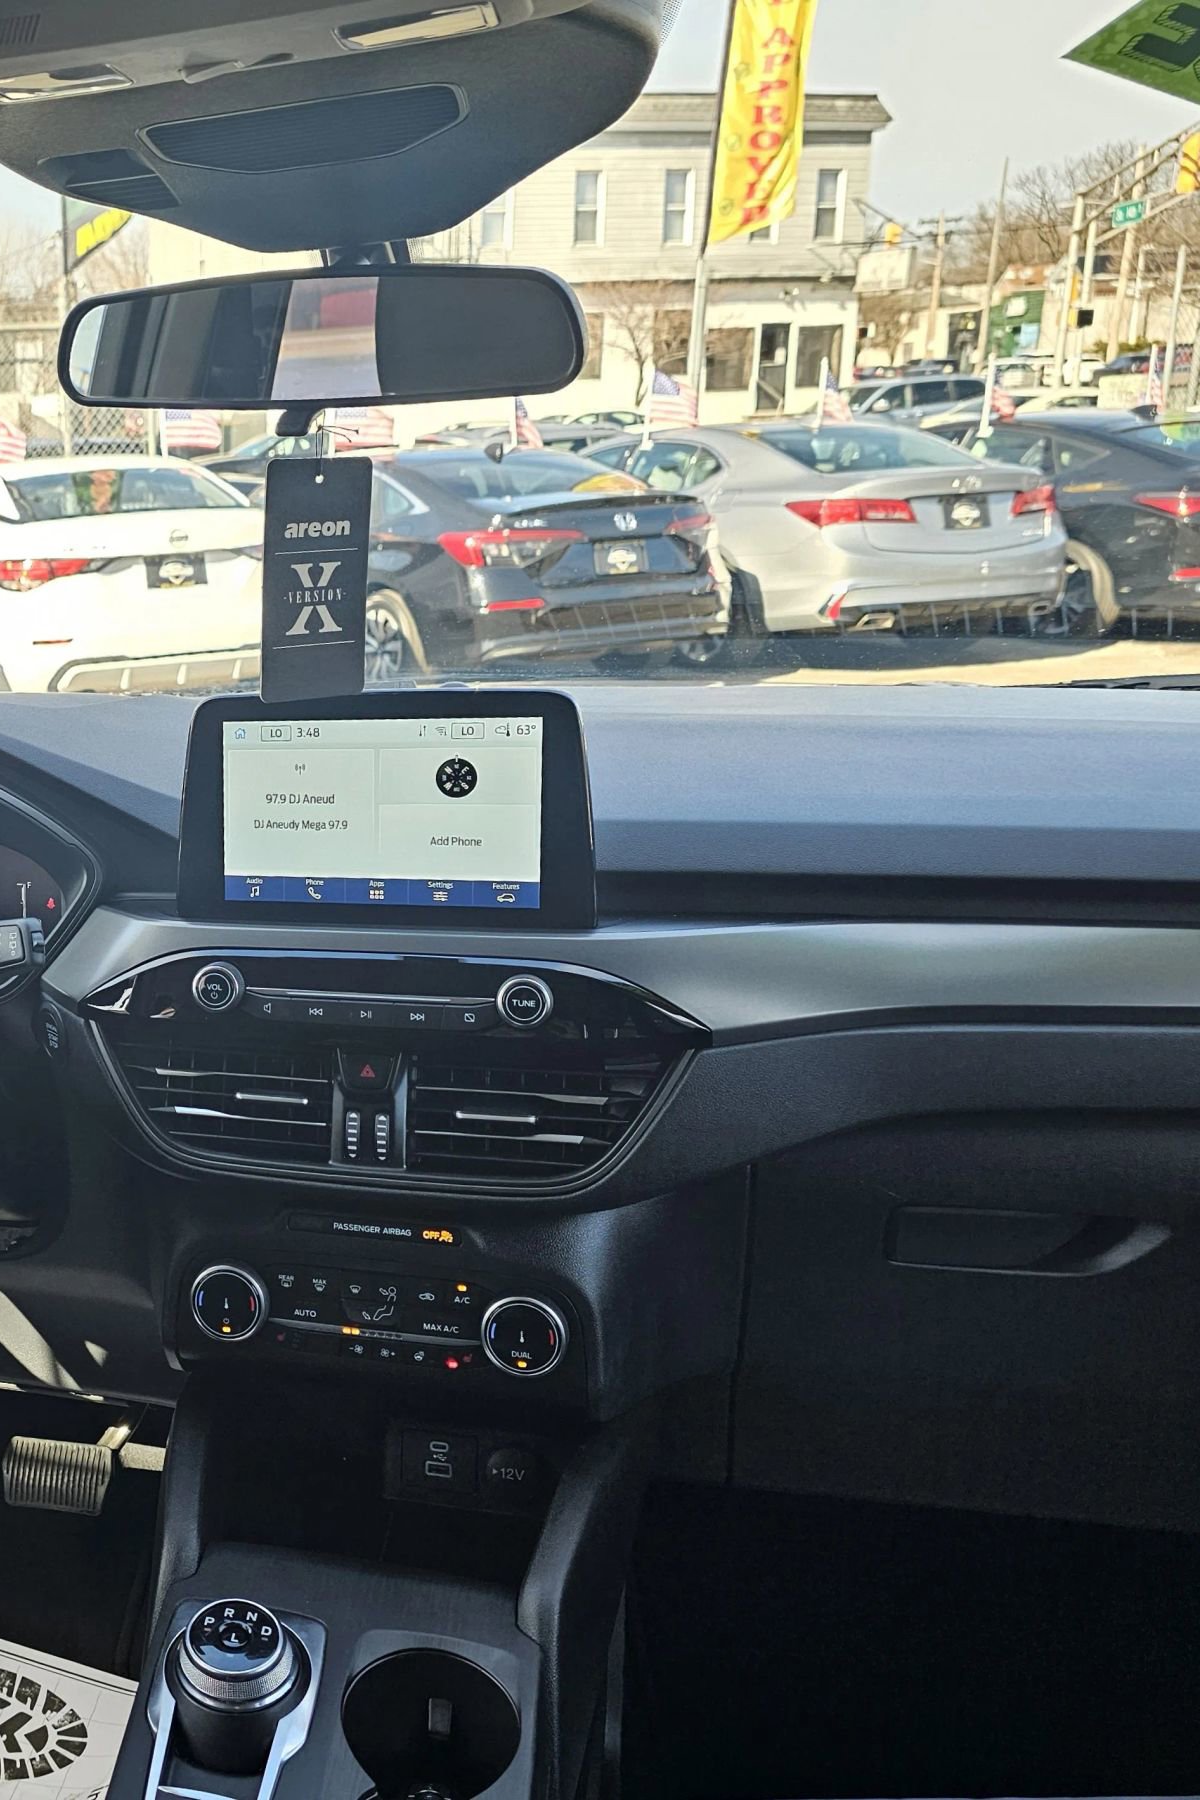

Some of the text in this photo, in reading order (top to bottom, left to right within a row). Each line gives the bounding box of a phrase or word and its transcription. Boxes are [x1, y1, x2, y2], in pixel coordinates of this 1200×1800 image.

[285, 520, 350, 539] areon
[270, 729, 282, 738] LO
[296, 727, 320, 738] 3:48
[461, 726, 474, 736] LO
[266, 794, 335, 804] 97.9 DJ Aneud
[254, 820, 348, 831] DJ Aneudy Mega 97.9
[430, 836, 482, 847] Add Phone
[306, 878, 324, 886] Phone
[368, 880, 384, 888] Apps
[428, 881, 454, 890] Settings
[492, 882, 520, 890] Features
[512, 998, 536, 1008] TUNE
[333, 1222, 440, 1240] PASSENGER AIRBAG OFF
[454, 1296, 470, 1304] A/C
[294, 1308, 316, 1318] AUTO
[423, 1323, 460, 1334] MAX A/C
[511, 1350, 532, 1360] DUAL
[500, 1468, 525, 1481] 12V
[224, 1608, 235, 1618] R
[246, 1612, 258, 1622] N
[204, 1616, 215, 1626] P
[260, 1626, 272, 1636] D
[230, 1632, 239, 1642] L
